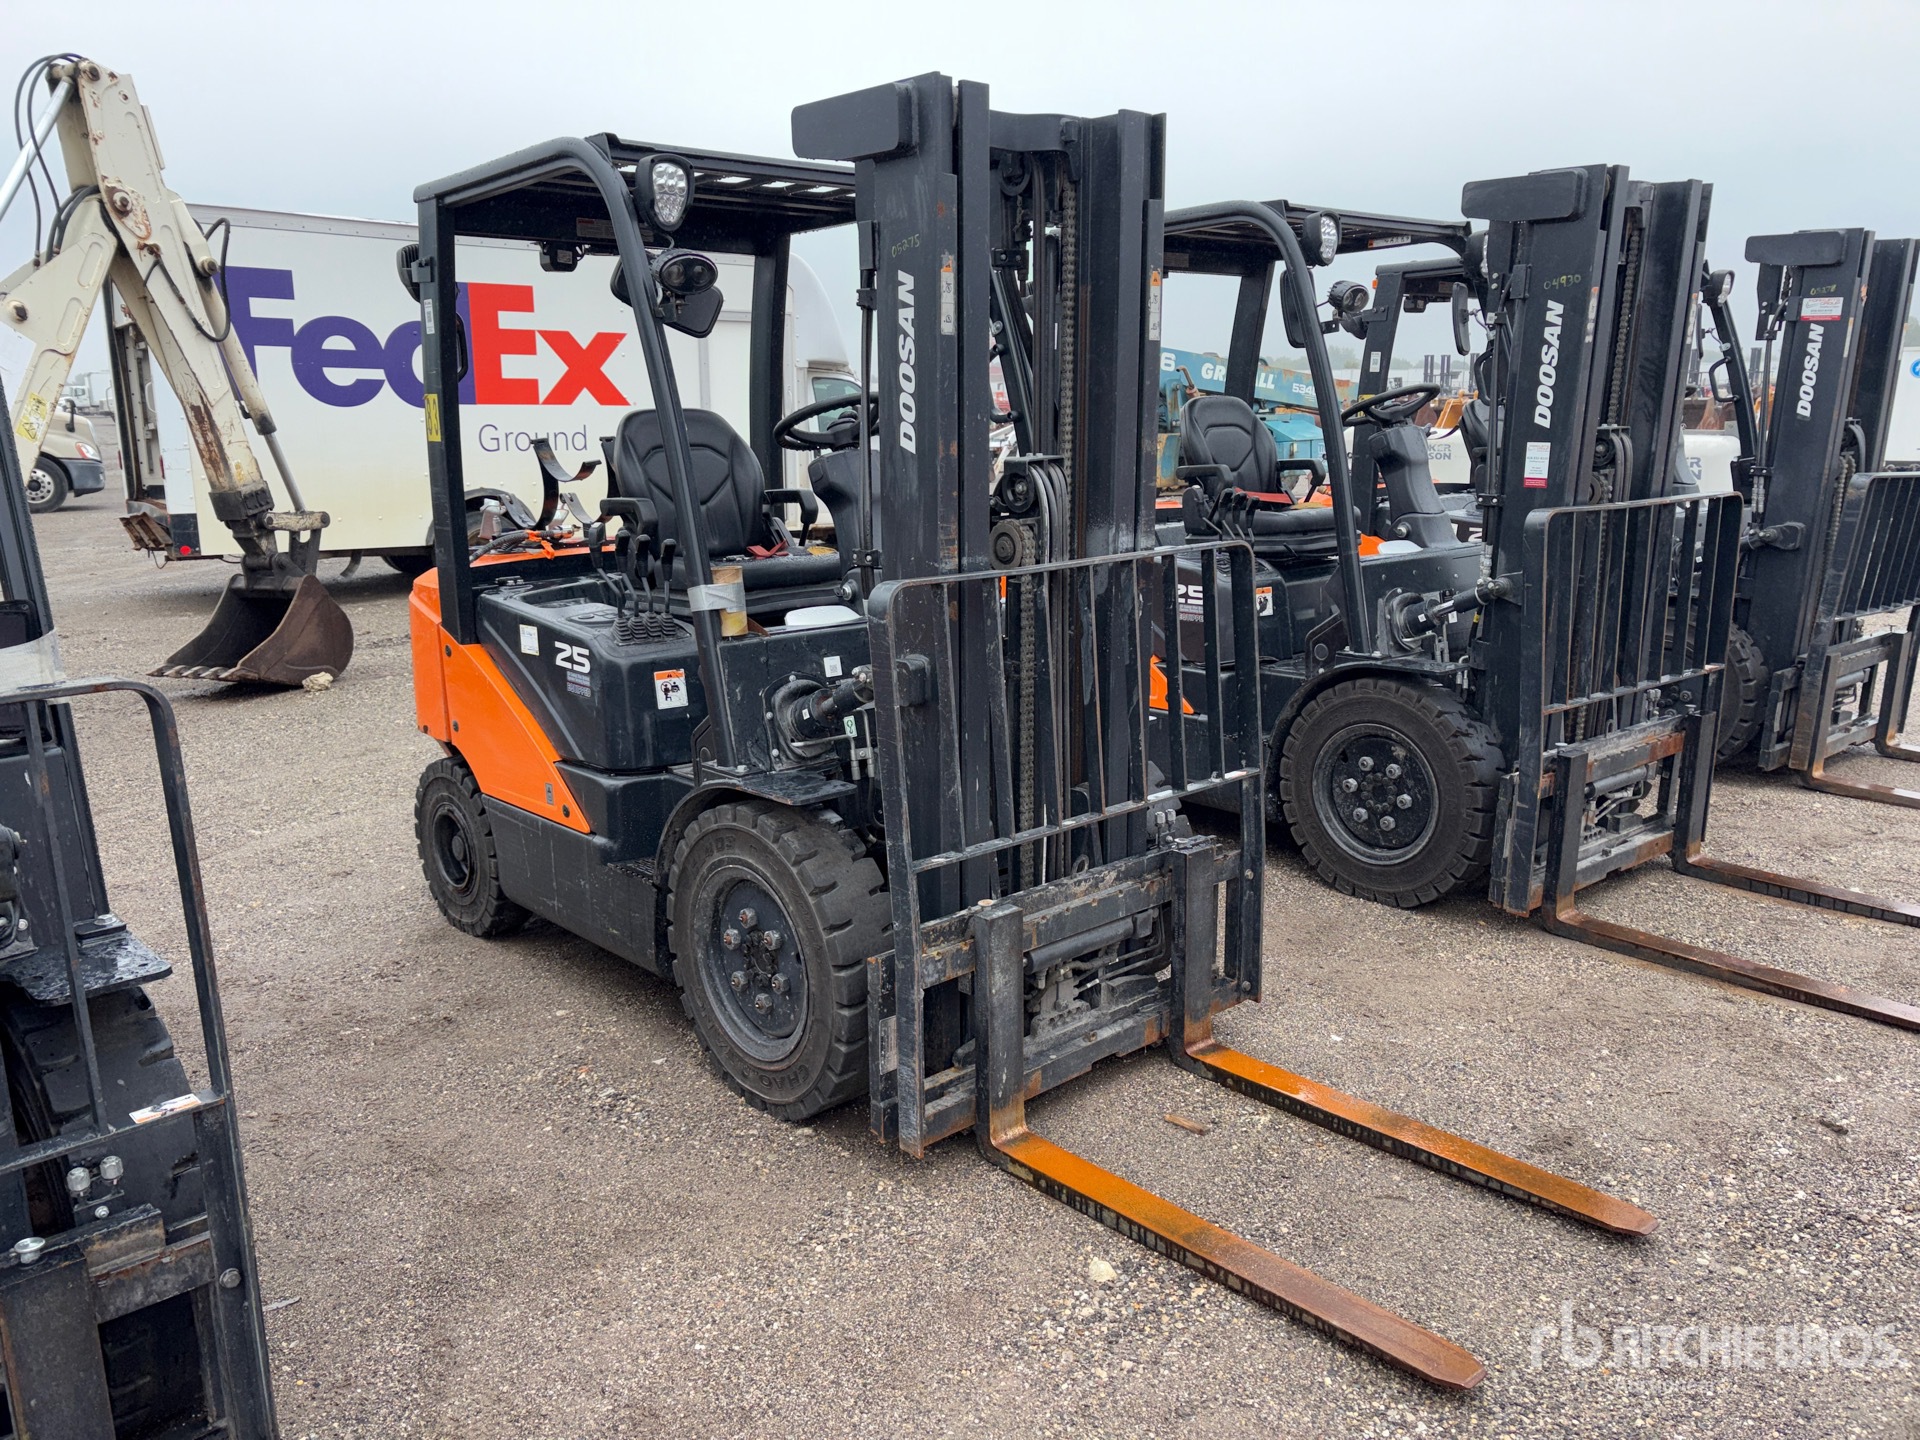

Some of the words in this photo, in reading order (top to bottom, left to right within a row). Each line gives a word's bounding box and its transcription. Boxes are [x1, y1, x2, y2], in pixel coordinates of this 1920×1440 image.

[217, 266, 632, 408] FedEx
[898, 269, 917, 455] DOOSAN
[1201, 362, 1276, 390] GRLL
[1534, 300, 1565, 429] DOOSAN
[1796, 323, 1825, 418] DOOSAN
[1292, 382, 1316, 396] 534
[554, 640, 591, 674] 25
